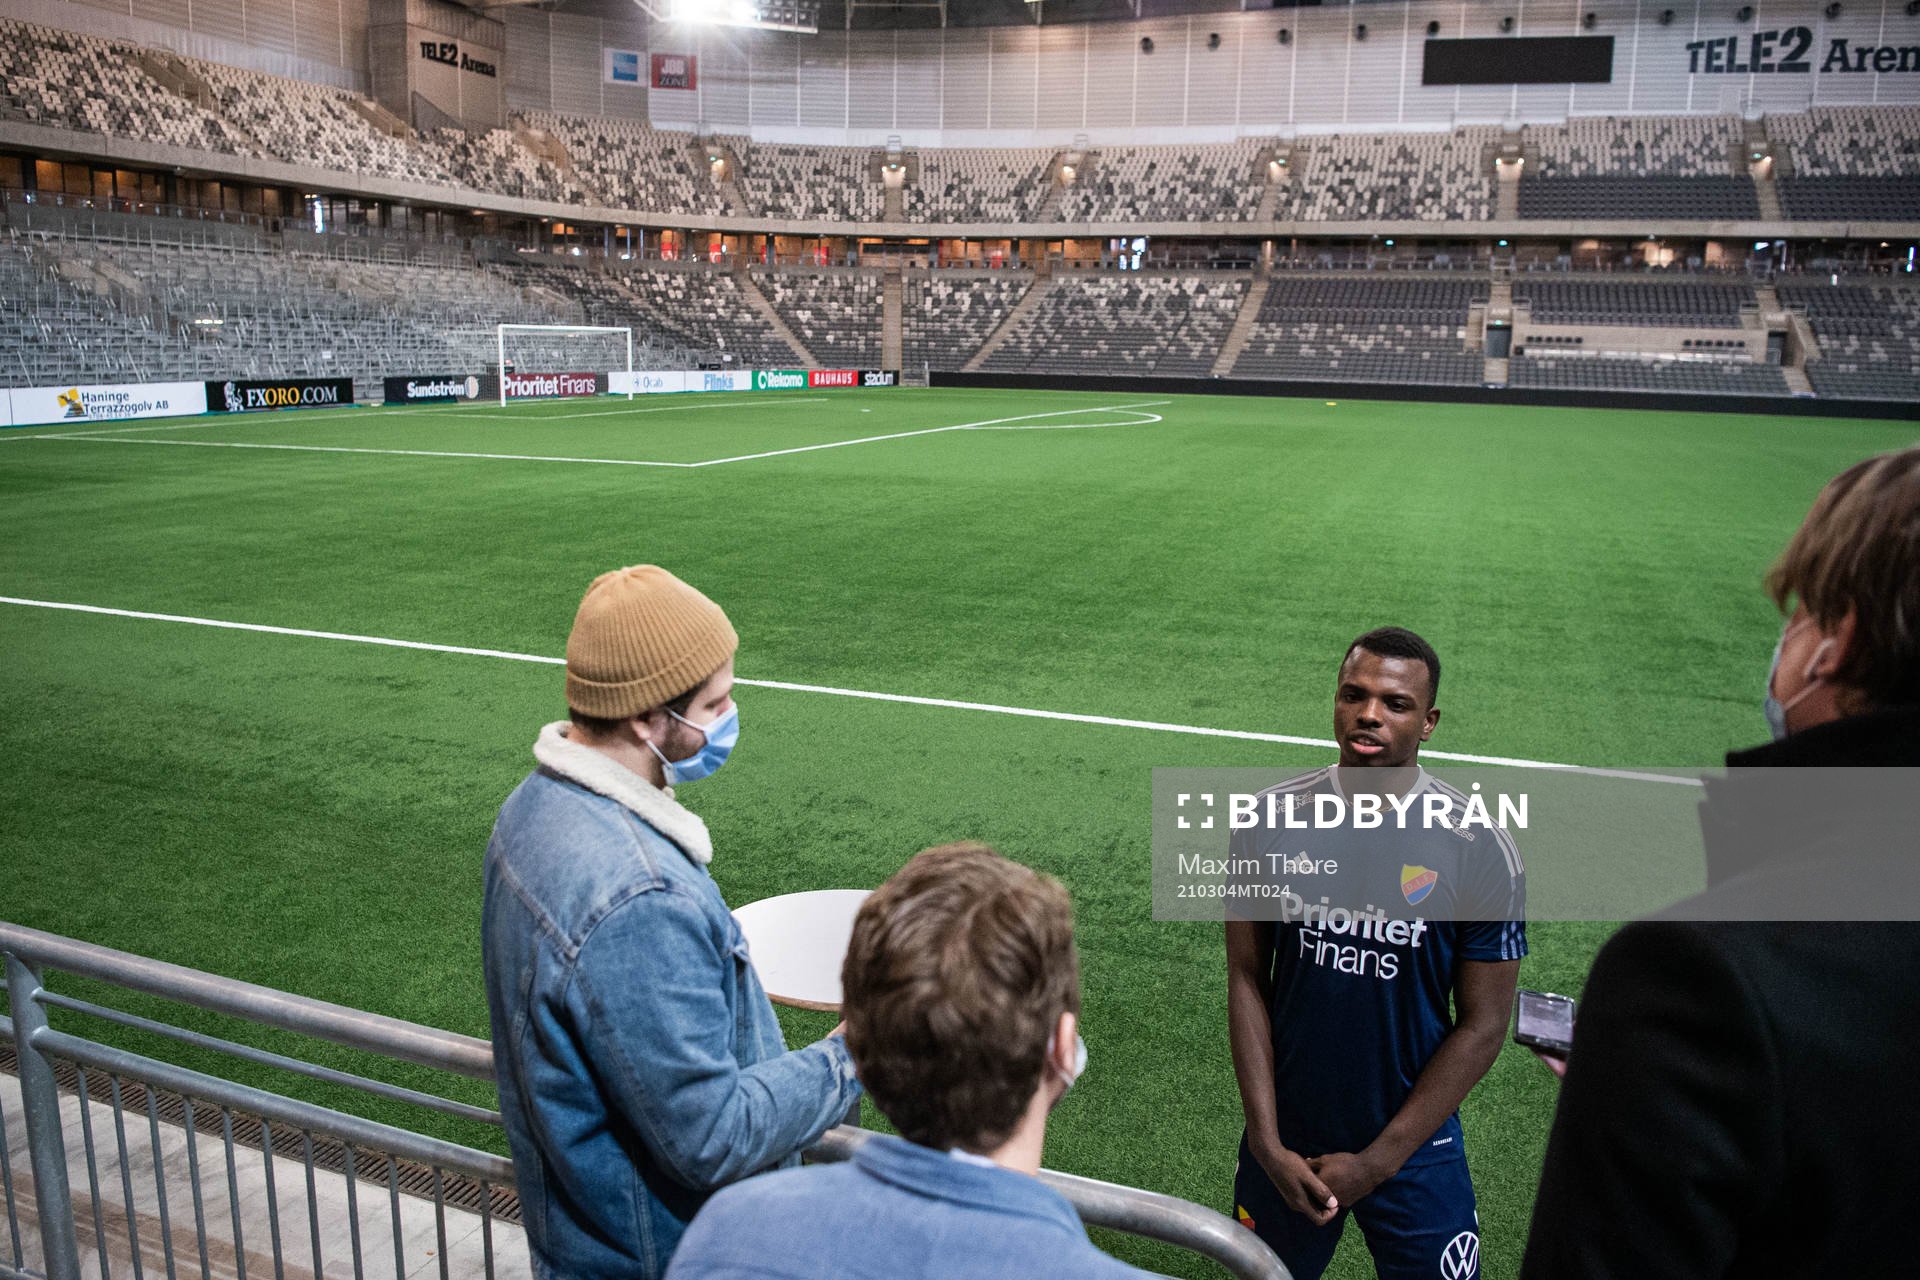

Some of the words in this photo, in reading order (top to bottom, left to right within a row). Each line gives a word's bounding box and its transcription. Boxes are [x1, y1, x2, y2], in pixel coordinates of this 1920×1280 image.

[1686, 26, 1813, 73] TELE2
[420, 42, 458, 67] TELE2
[461, 52, 496, 78] Arena
[504, 375, 558, 396] Prioritet
[560, 375, 595, 394] Finans
[814, 373, 852, 384] BAUHAUS
[864, 372, 893, 386] stadium
[81, 392, 129, 404] Haninge
[246, 386, 338, 406] FXORO.COM
[407, 381, 464, 398] Sundström
[84, 401, 152, 415] Terrazzogolv
[155, 400, 169, 410] AB
[1280, 893, 1427, 947] Prioritet
[1299, 928, 1399, 980] Finans
